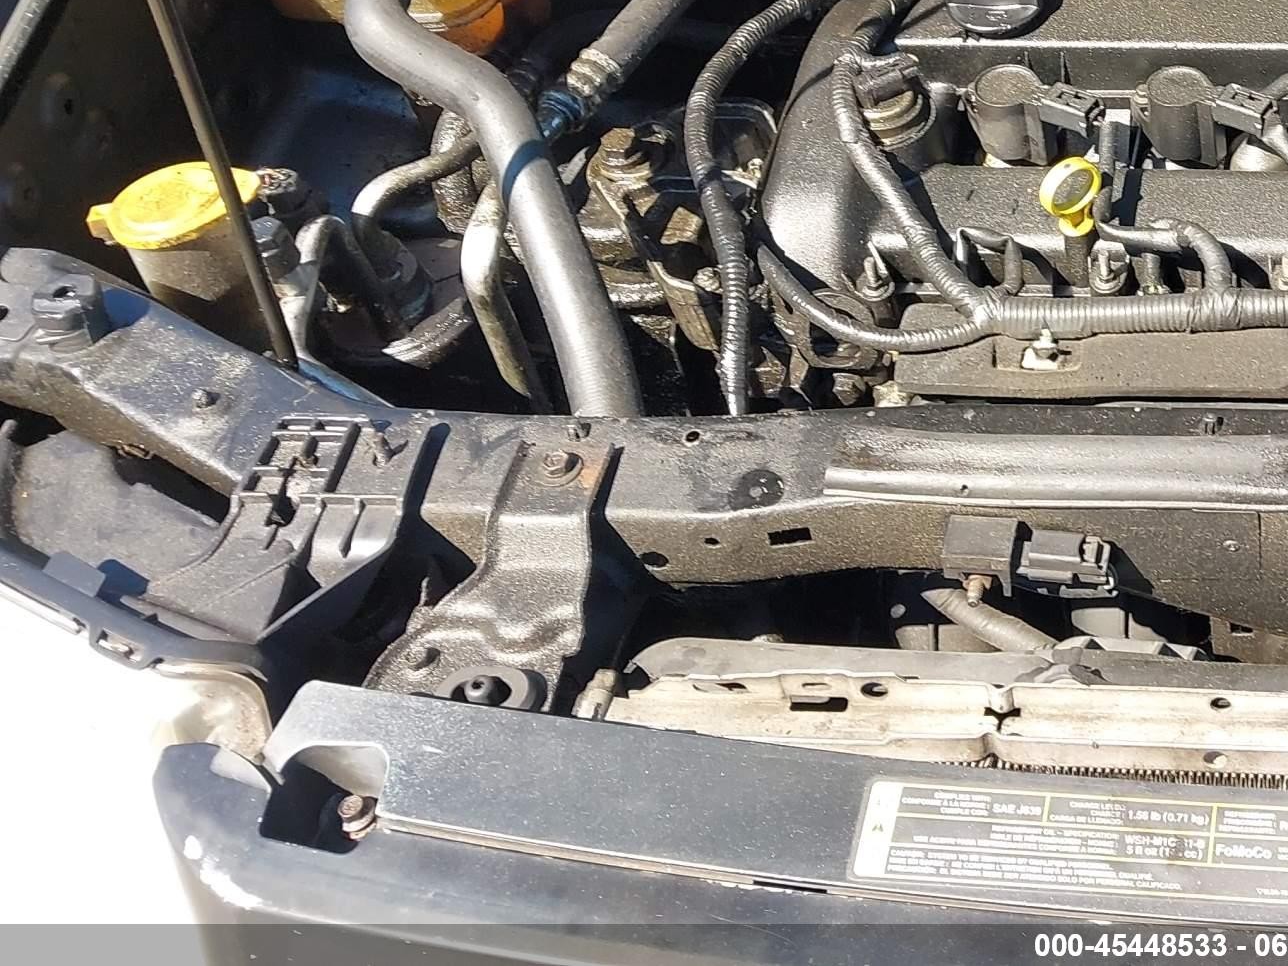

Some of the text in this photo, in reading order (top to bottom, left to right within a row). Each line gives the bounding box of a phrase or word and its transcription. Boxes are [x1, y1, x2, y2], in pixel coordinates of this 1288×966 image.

[993, 803, 1016, 814] SAE
[1163, 811, 1189, 825] (0.71
[1215, 843, 1272, 860] FoMoCo
